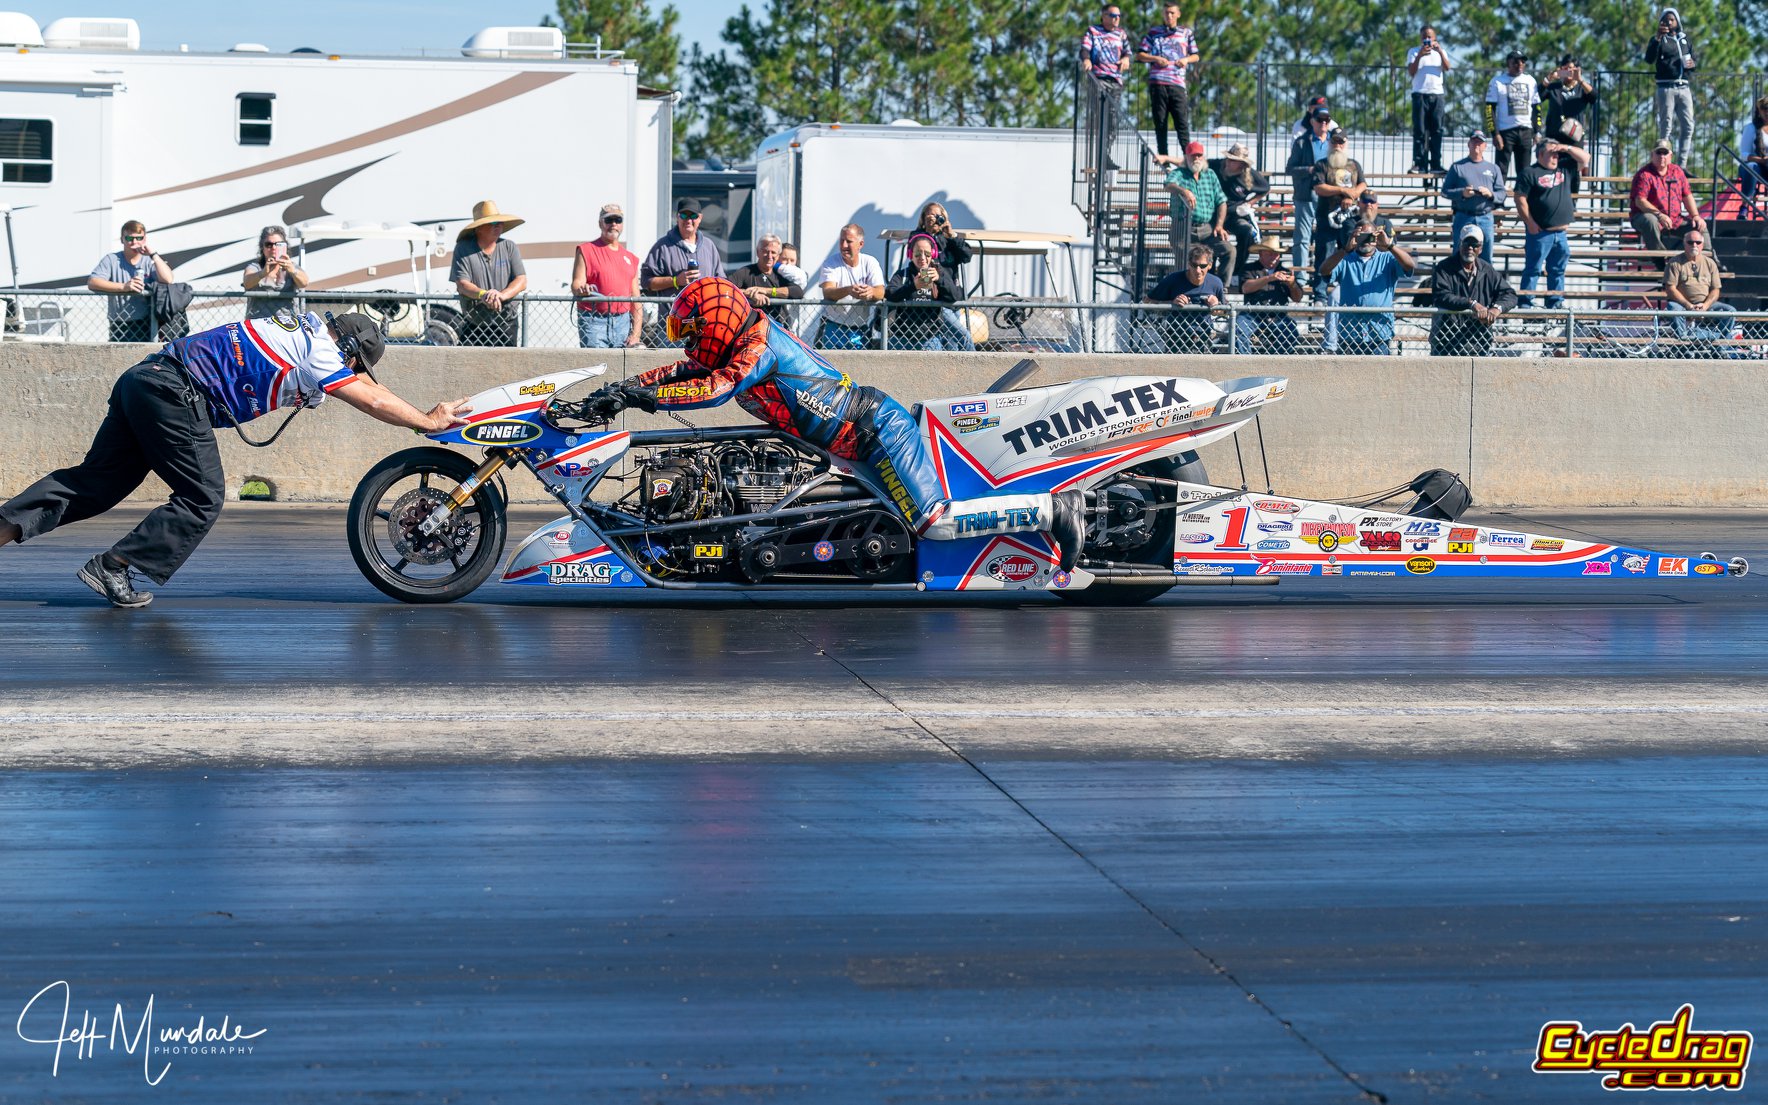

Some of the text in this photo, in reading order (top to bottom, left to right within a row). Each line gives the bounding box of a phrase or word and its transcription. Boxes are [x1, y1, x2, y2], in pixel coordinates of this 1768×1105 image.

[801, 390, 832, 417] DRAG
[953, 403, 985, 414] APE
[1003, 379, 1189, 455] TRIM-TEX
[1049, 430, 1096, 450] WORLD'S
[1099, 413, 1157, 434] STRONGEST
[555, 463, 581, 477] VP
[954, 507, 1040, 533] TRIM-TEX
[1359, 517, 1379, 526] PR
[1214, 506, 1250, 551] 1
[1406, 521, 1441, 532] MPS
[1360, 530, 1401, 541] VALCO
[1491, 534, 1524, 543] Ferrea
[1257, 540, 1290, 549] COMETIC
[1448, 542, 1473, 553] PJ1
[695, 545, 724, 557] PJ1
[1002, 563, 1035, 573] RED LINE
[1583, 562, 1611, 573] XDA
[1659, 558, 1687, 571] EK
[1696, 565, 1712, 573] BST
[549, 563, 611, 578] DRAG
